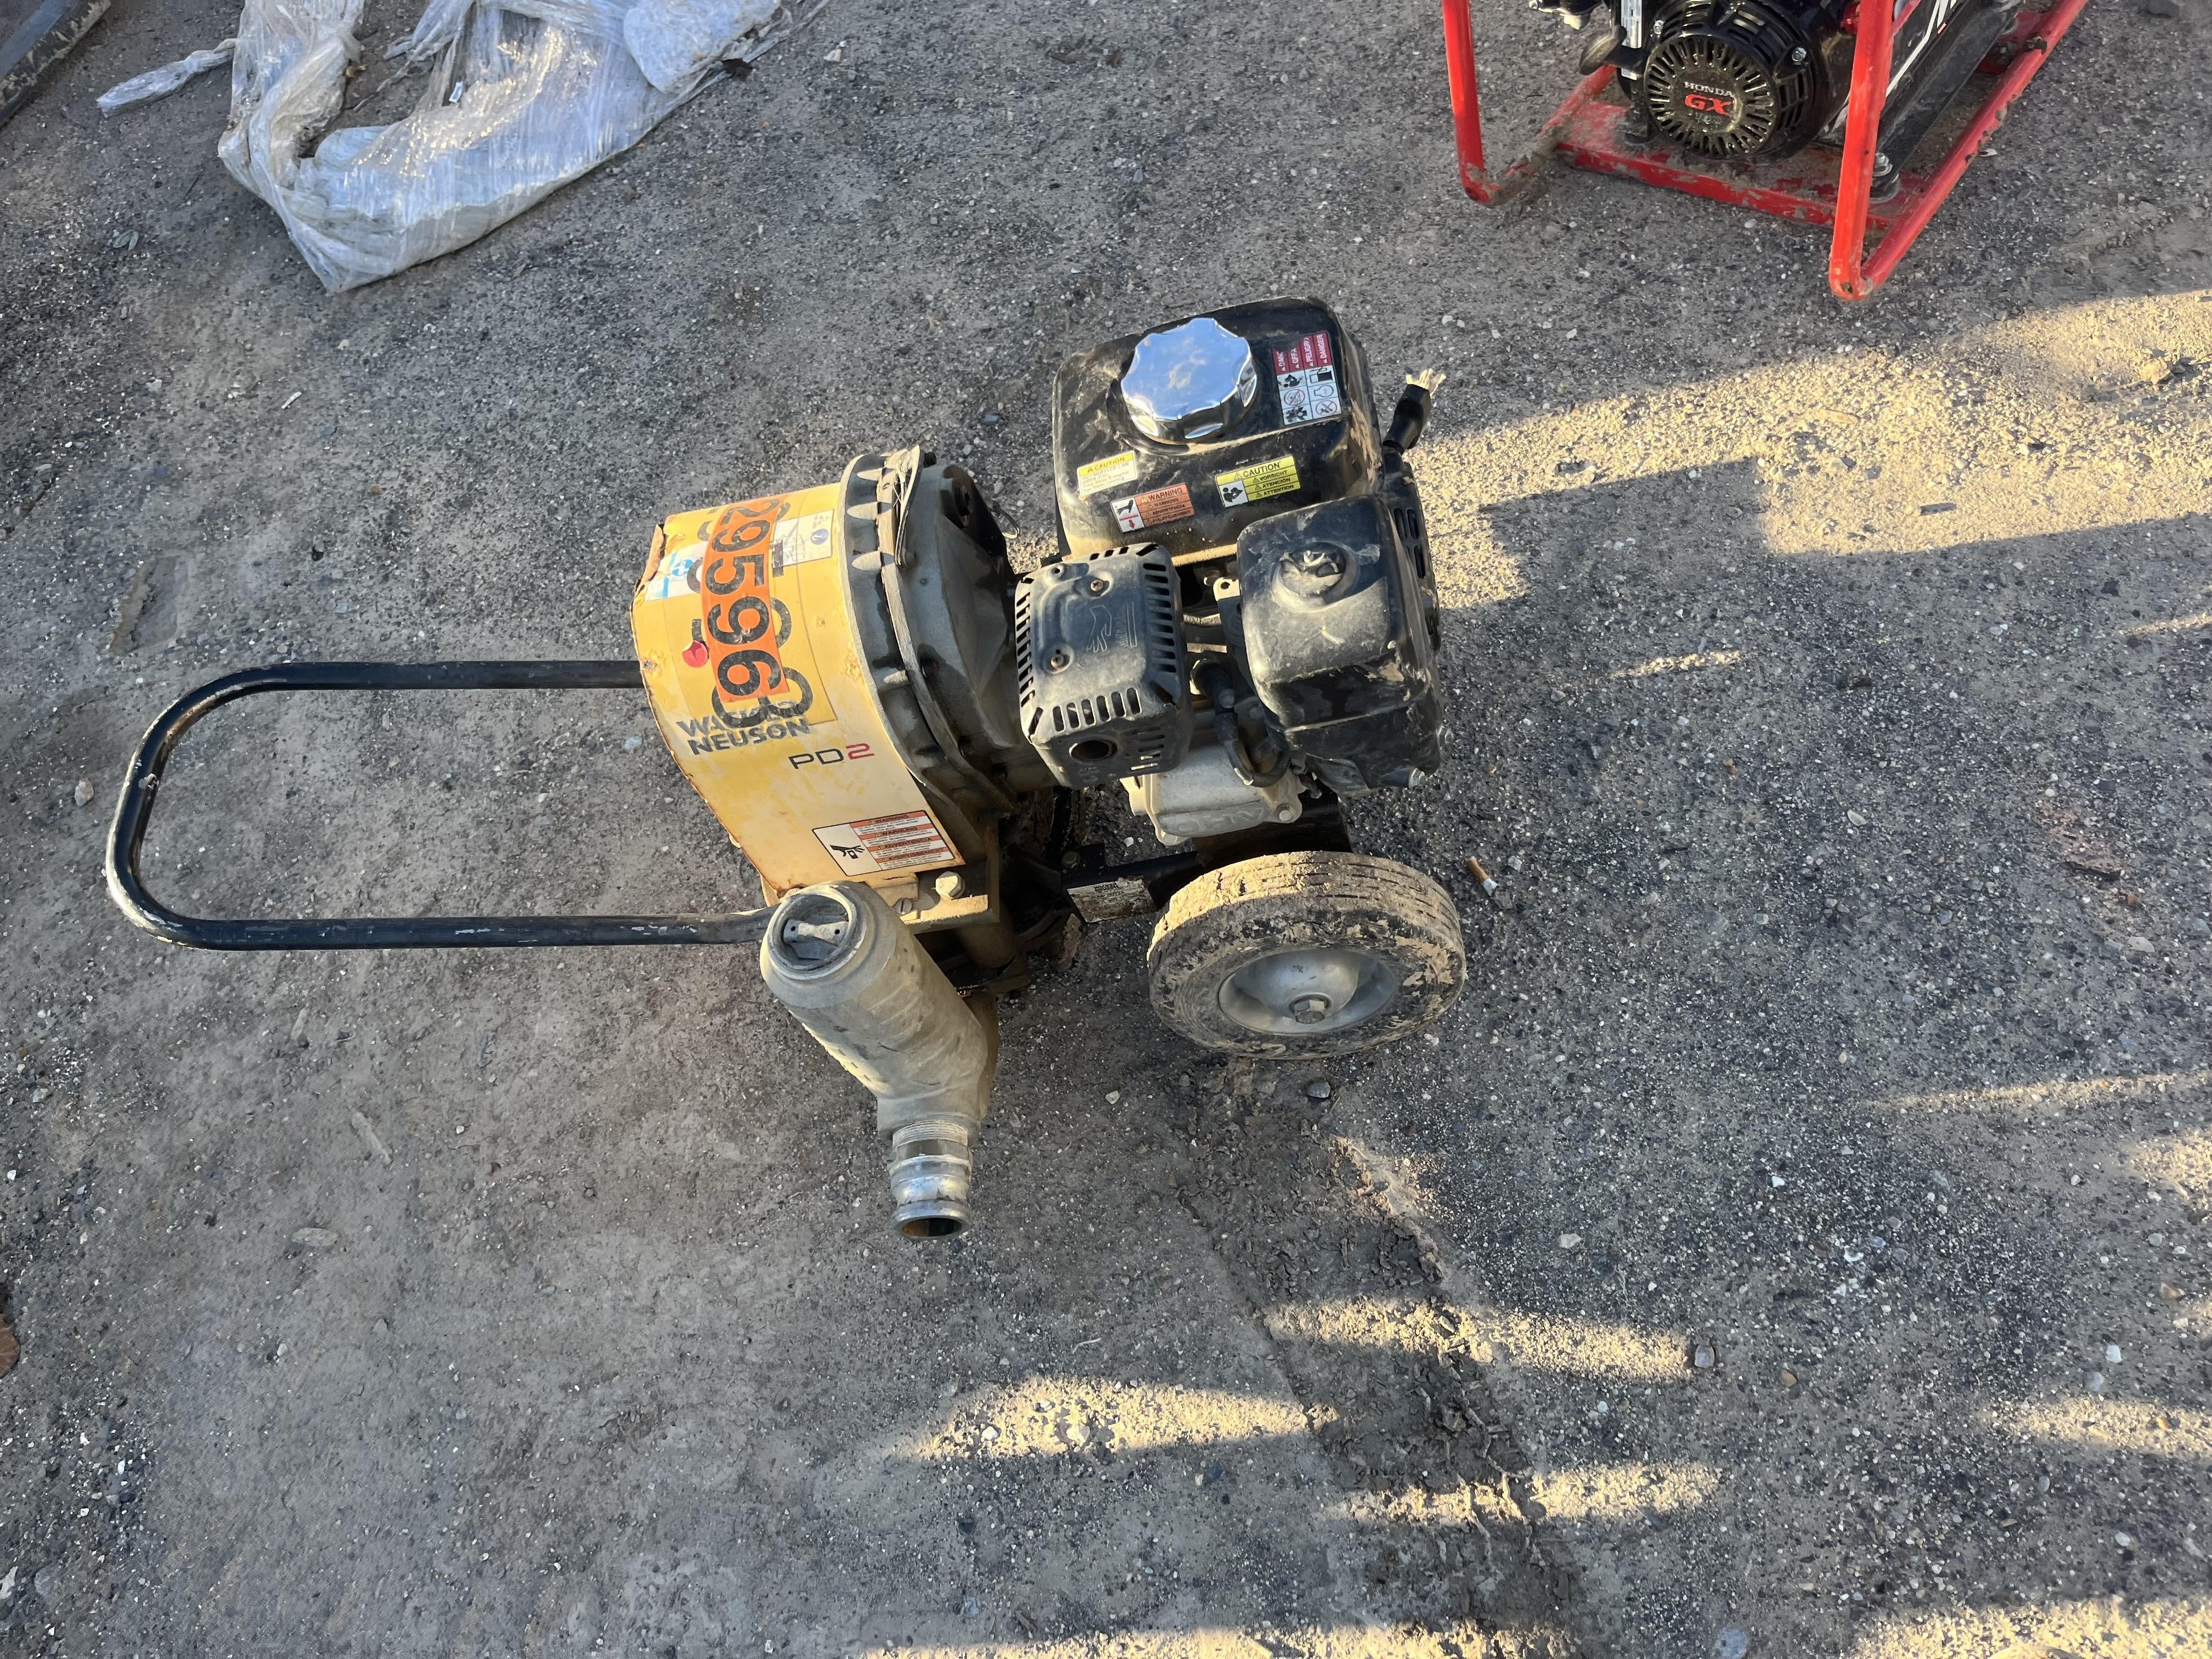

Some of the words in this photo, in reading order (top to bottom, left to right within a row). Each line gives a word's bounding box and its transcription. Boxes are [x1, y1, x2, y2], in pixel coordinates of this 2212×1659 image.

[1684, 81, 1735, 98] HONDA
[1685, 94, 1732, 116] GX
[1317, 334, 1327, 359] DANGER
[1094, 457, 1125, 470] CAUTION
[1243, 462, 1280, 477] CAUTION
[1259, 470, 1288, 481] VORSICHT
[1148, 488, 1183, 501] WARNING
[1263, 484, 1294, 495] ATTENTION
[706, 498, 783, 697] 29596
[687, 718, 811, 755] NEUSON
[788, 743, 875, 770] PD2
